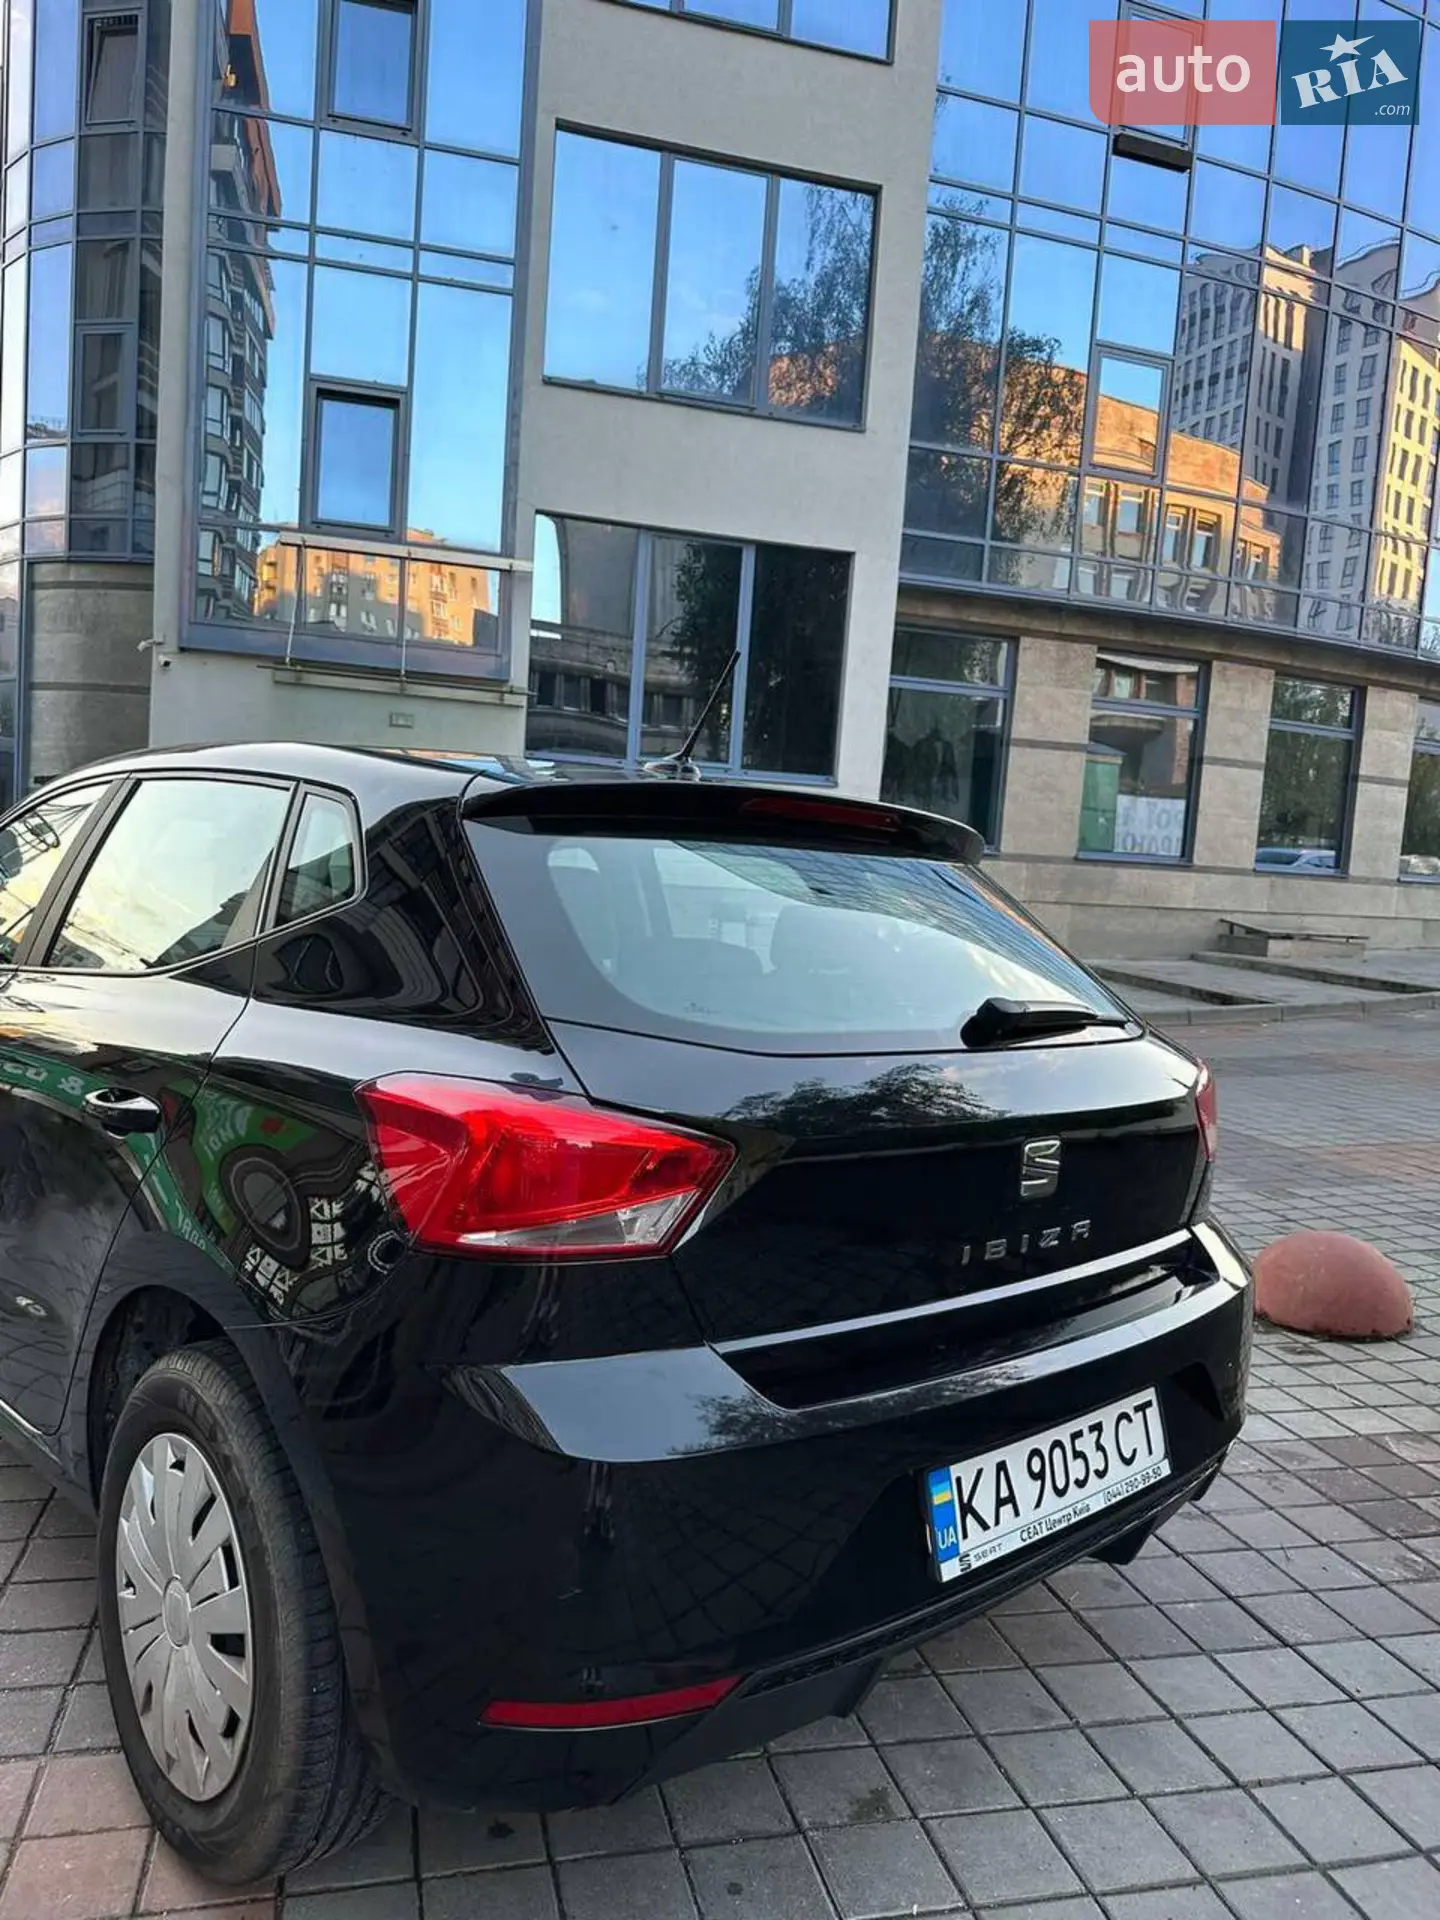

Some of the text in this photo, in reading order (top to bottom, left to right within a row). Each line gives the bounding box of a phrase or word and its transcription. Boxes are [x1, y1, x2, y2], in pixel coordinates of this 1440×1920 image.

[961, 1219, 1092, 1266] IBIZA
[955, 1399, 1154, 1541] KA 9053 CT
[937, 1525, 957, 1549] UA
[973, 1542, 1003, 1562] SEAT
